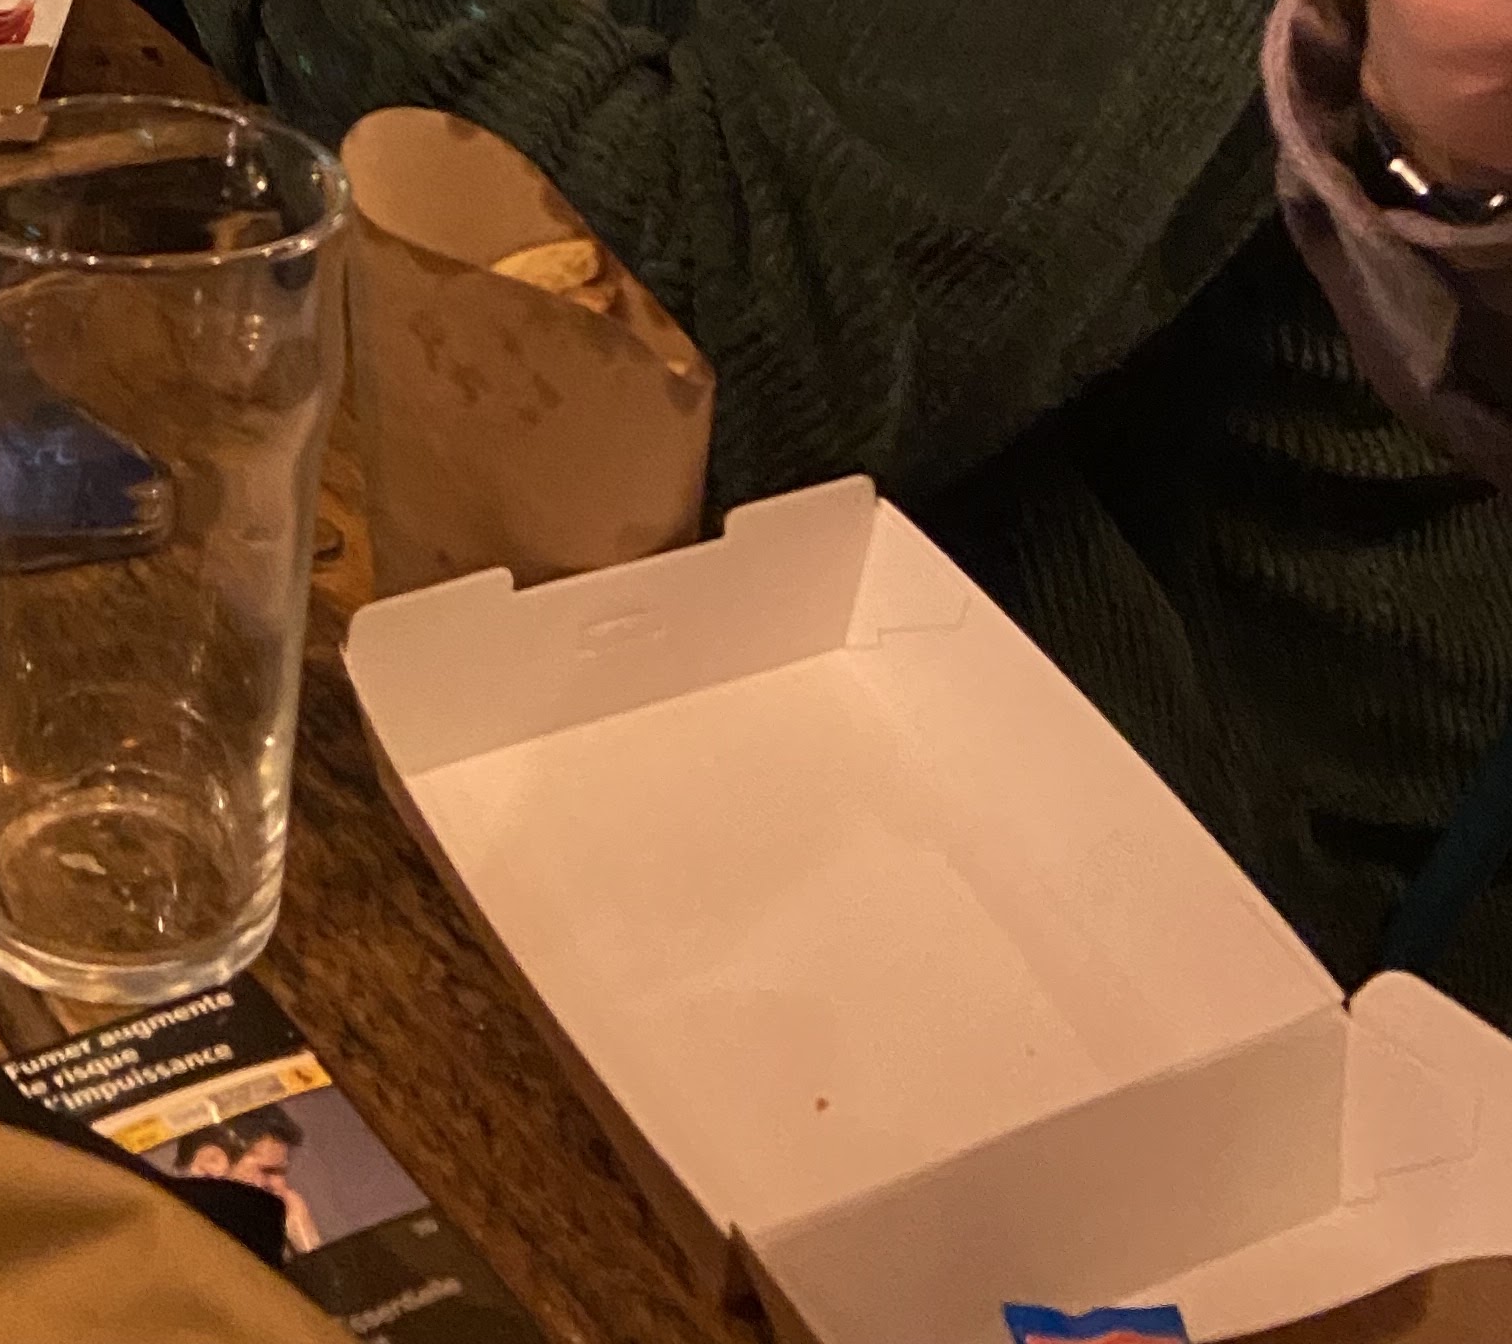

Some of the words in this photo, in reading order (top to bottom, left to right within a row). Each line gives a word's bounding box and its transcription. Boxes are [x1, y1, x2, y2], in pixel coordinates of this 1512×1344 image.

[4, 1038, 91, 1081] Fumer
[99, 991, 235, 1048] augmente
[53, 1048, 139, 1088] risque
